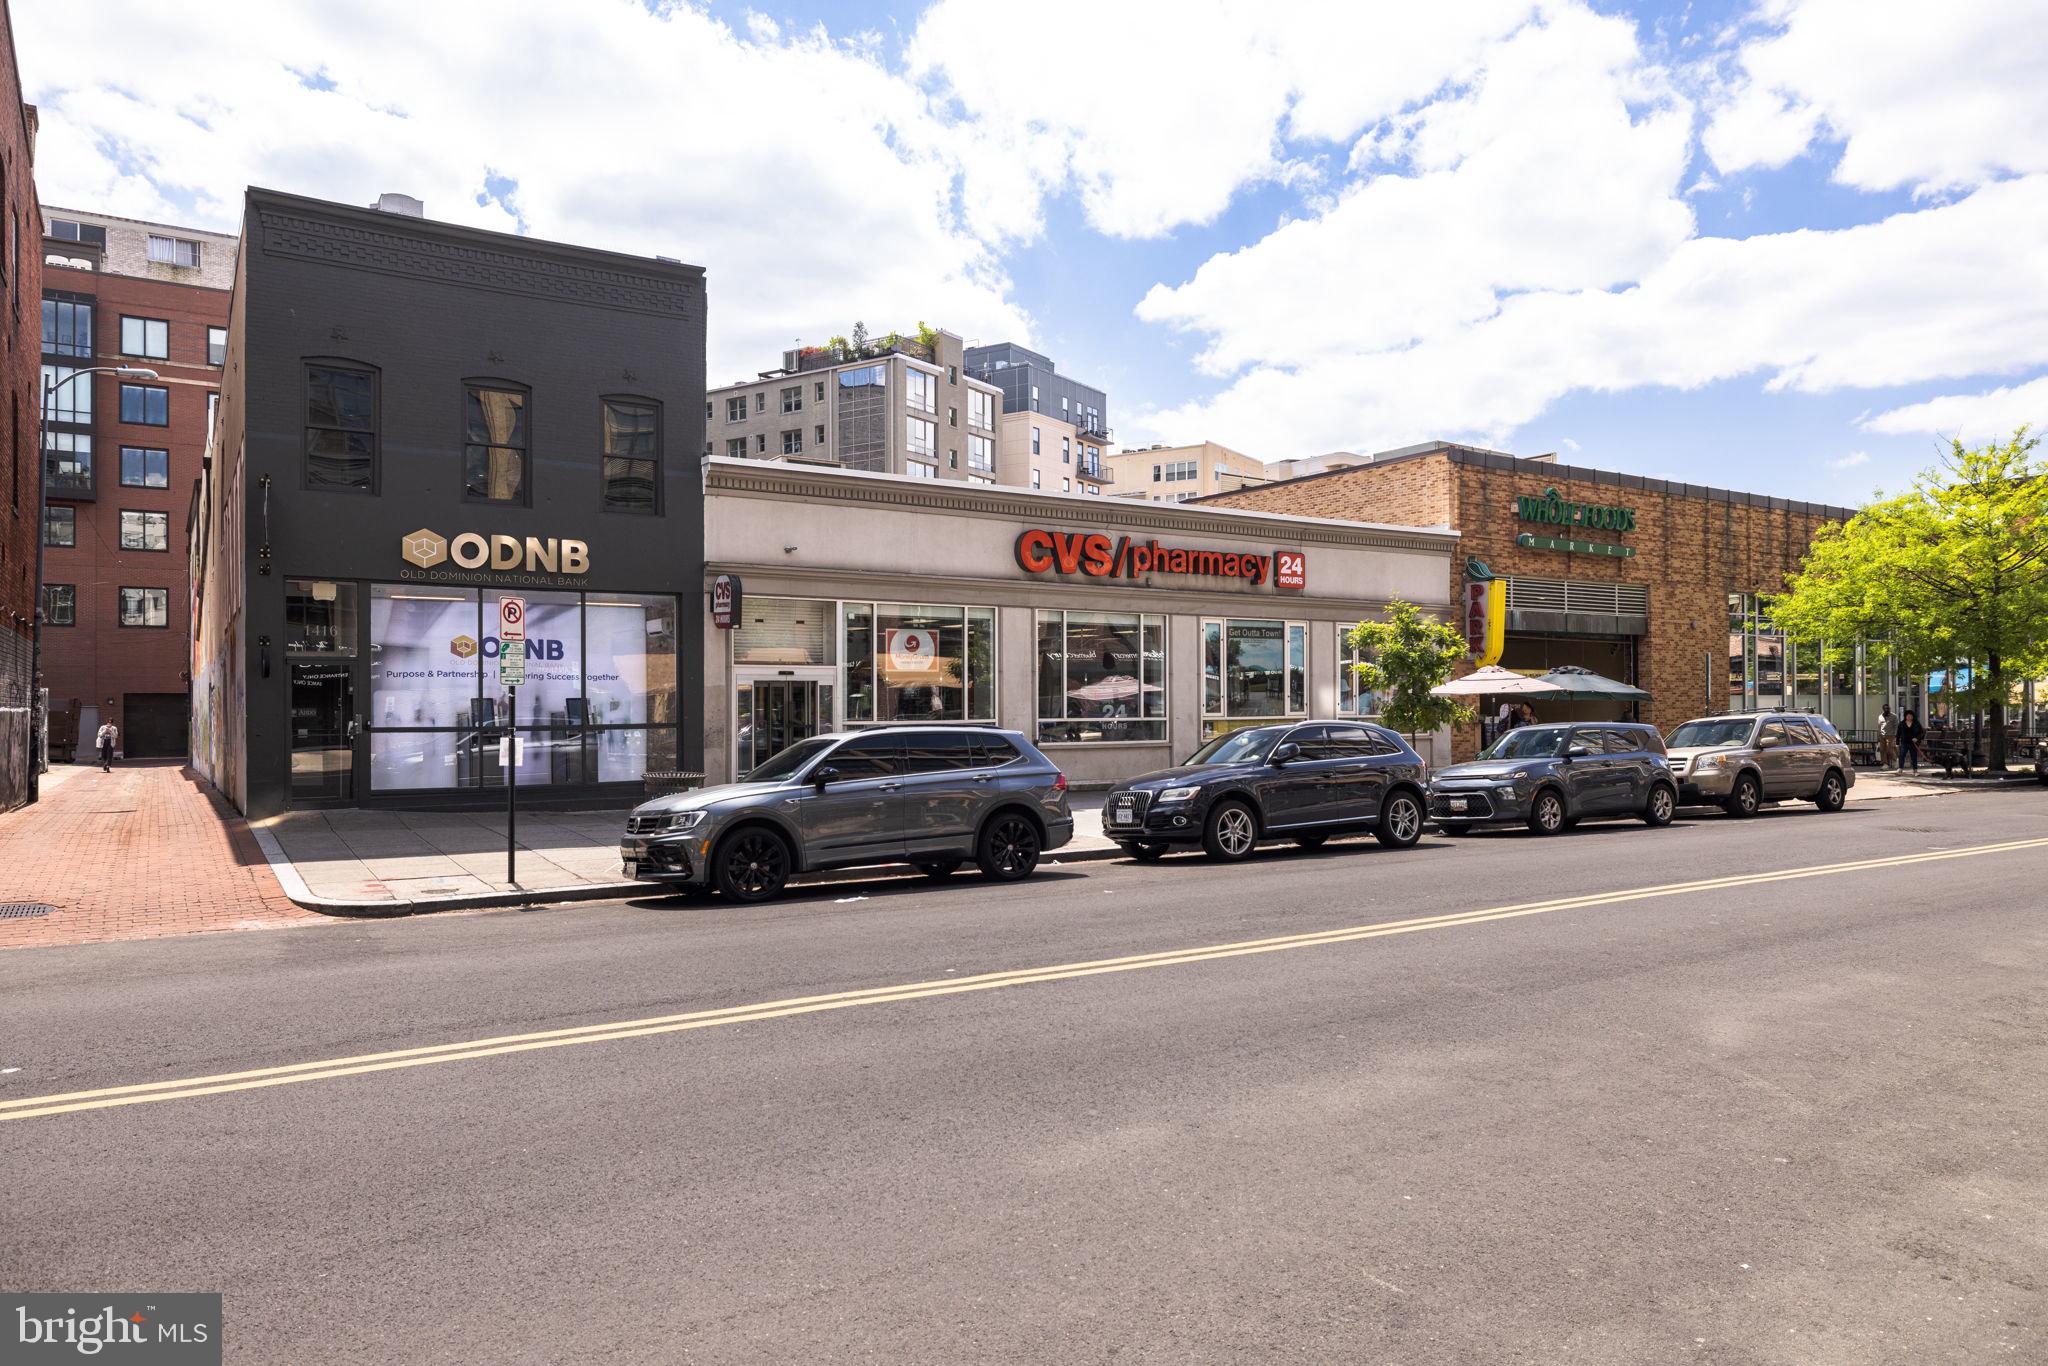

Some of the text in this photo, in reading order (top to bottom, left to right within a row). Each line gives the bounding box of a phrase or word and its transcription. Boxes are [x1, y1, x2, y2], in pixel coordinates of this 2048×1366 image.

[1517, 495, 1637, 532] WHOLE FOODS
[450, 532, 590, 574] ODNB
[1528, 537, 1631, 557] MARKET
[1018, 529, 1272, 586] CVS/pharmacy
[1280, 555, 1303, 575] 24
[400, 569, 589, 587] OLD DOMINION NATIONAL BANK
[1279, 575, 1304, 586] HOURS
[716, 581, 731, 601] CVS
[1468, 584, 1486, 653] PARK
[304, 624, 338, 638] 1416
[1228, 629, 1281, 638] Get Outta Town!
[483, 636, 565, 661] ONB
[386, 670, 425, 680] Purpose
[427, 670, 435, 678] &
[546, 672, 580, 681] Success
[586, 673, 620, 682] ogether
[1102, 703, 1128, 719] 24
[1101, 722, 1128, 730] HOURS
